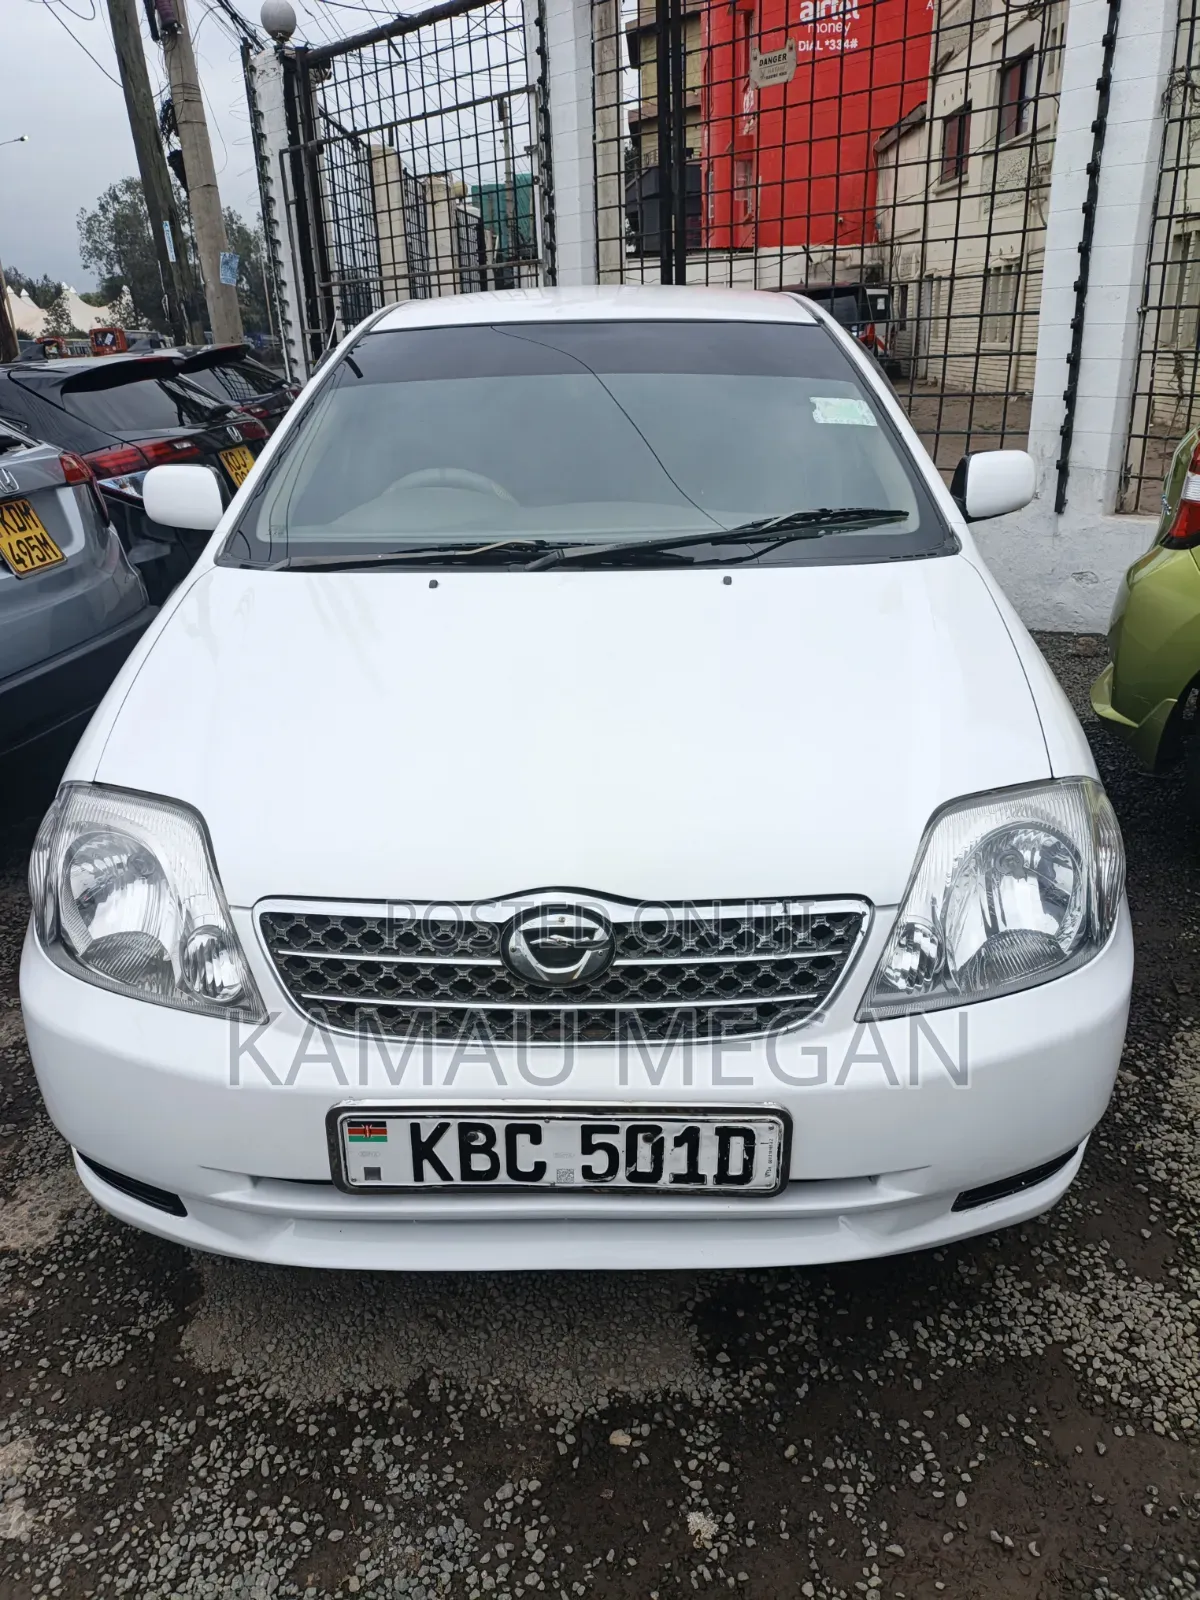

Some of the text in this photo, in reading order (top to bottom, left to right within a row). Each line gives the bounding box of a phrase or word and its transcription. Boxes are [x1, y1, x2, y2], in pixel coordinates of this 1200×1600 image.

[799, 0, 860, 21] airtel
[807, 22, 852, 36] money
[798, 40, 824, 52] DIAL
[759, 53, 787, 67] DANGER
[0, 501, 39, 536] KDM
[8, 532, 59, 569] 495M
[410, 1121, 547, 1182] KBC
[581, 1124, 756, 1185] 501D
